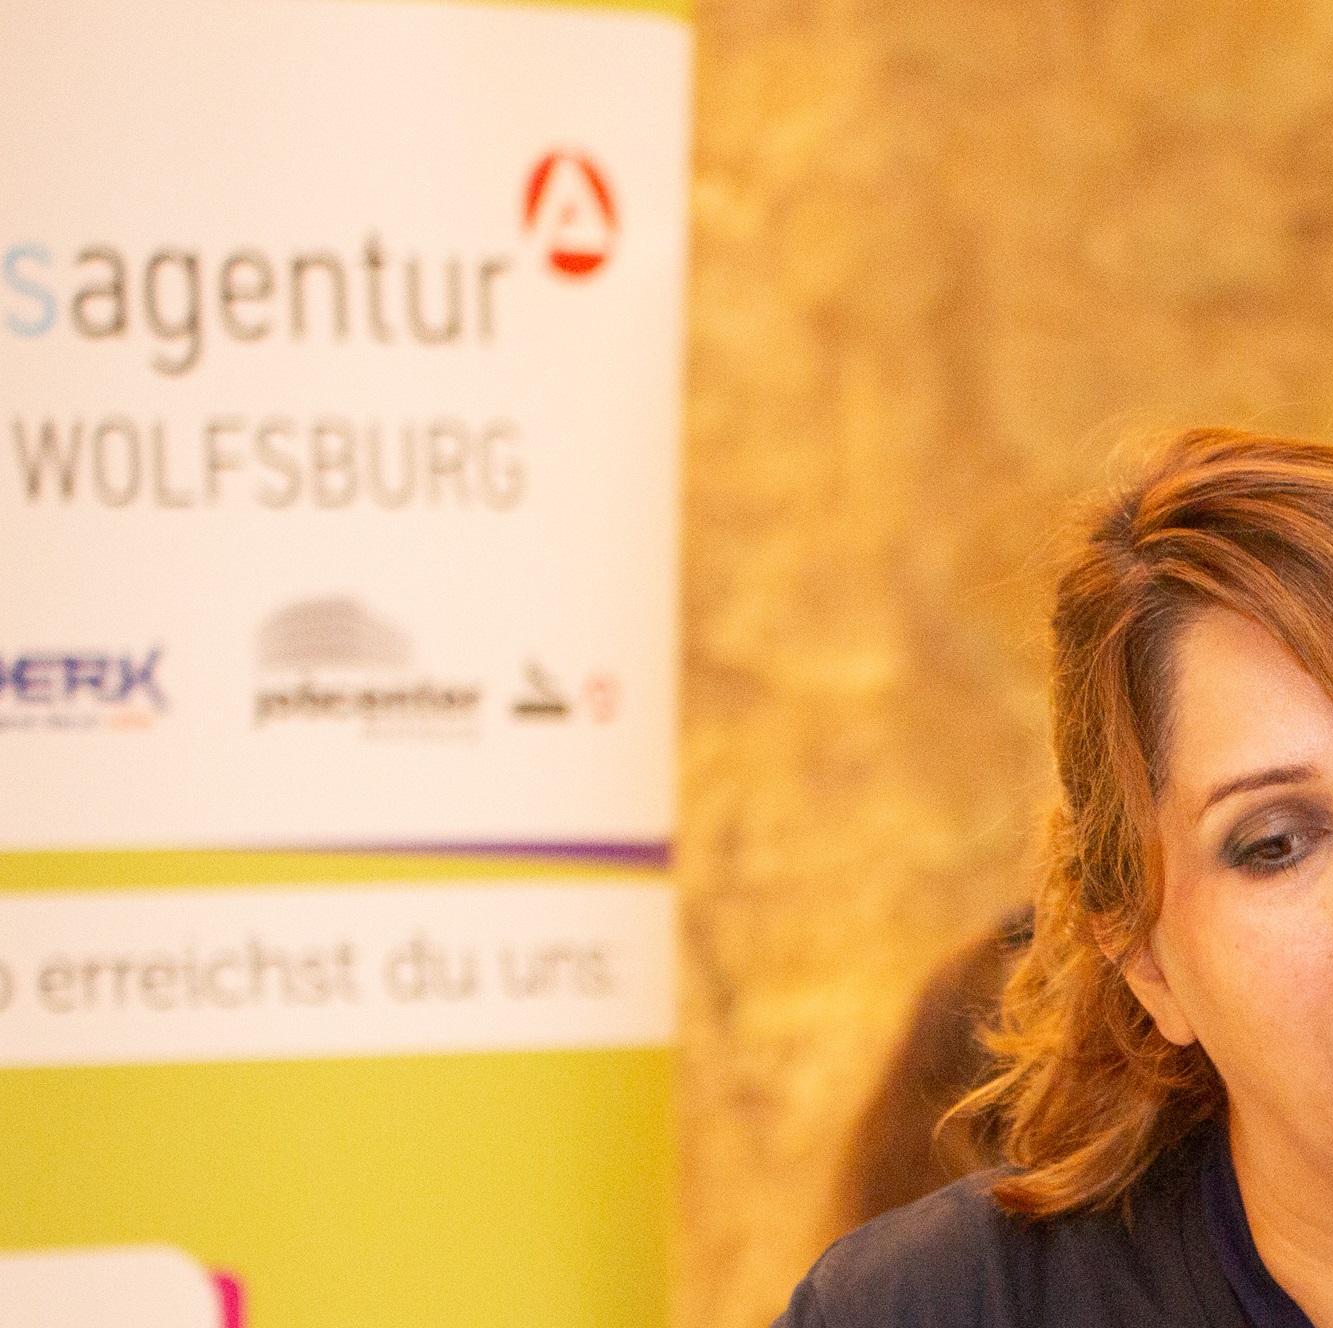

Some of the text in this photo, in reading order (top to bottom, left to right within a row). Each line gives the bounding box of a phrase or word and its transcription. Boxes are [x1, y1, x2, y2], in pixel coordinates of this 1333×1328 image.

[10, 412, 528, 511] WOLFSBURG
[36, 930, 358, 1014] erreichst
[382, 928, 478, 1003] du
